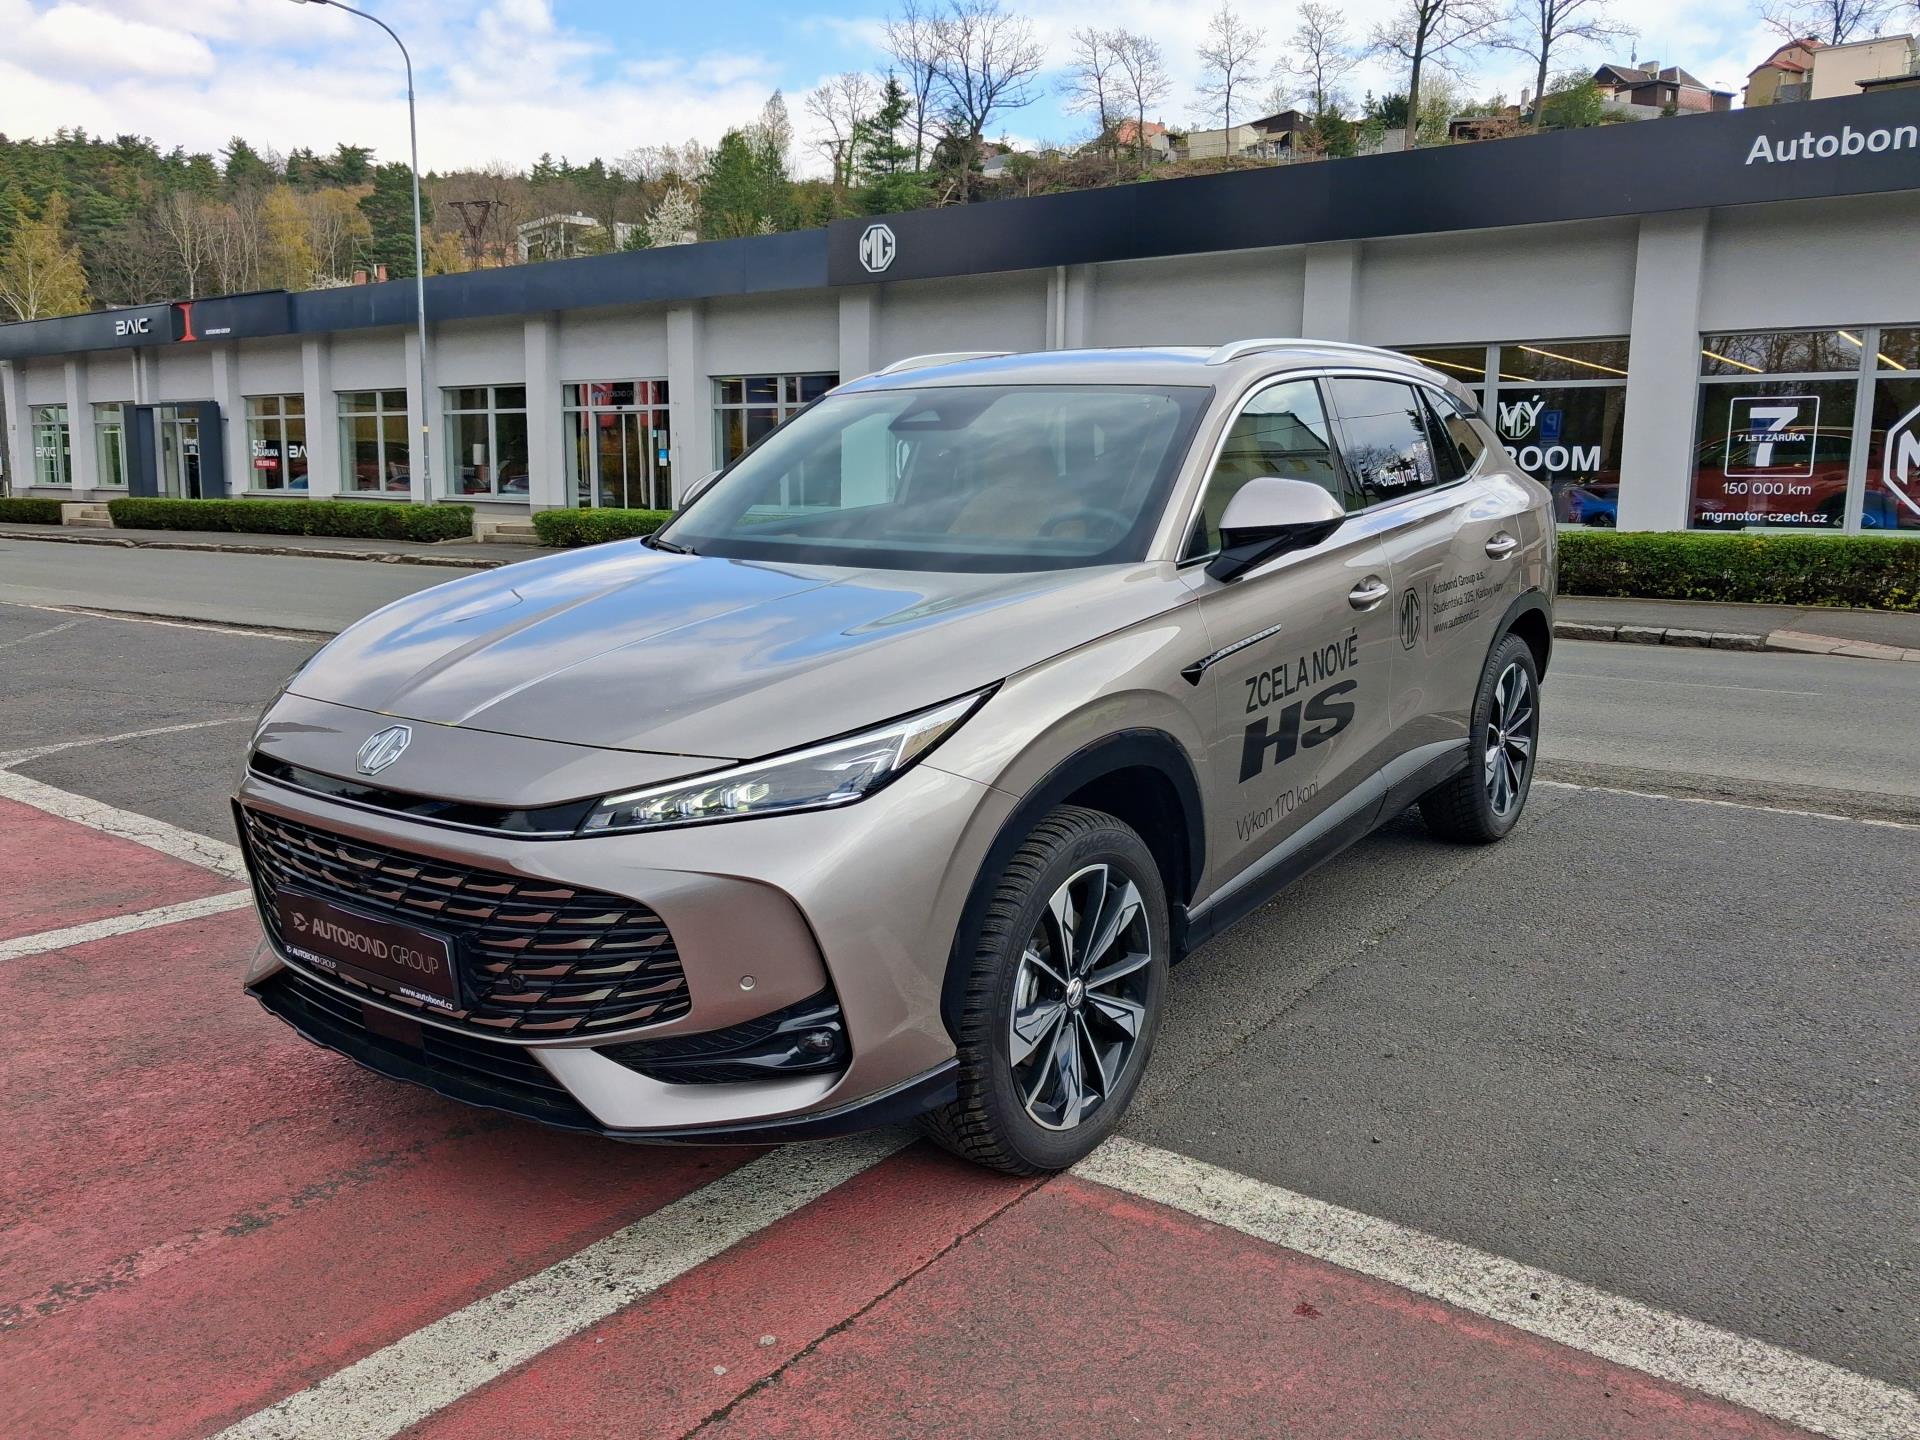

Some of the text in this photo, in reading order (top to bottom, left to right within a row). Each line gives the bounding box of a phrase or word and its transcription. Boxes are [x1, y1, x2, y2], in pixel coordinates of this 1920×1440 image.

[860, 223, 896, 273] MG
[115, 318, 149, 336] BAIC
[1737, 431, 1806, 442] 7 LET ZÁRUKA
[1722, 482, 1812, 495] 150 000 km
[1702, 510, 1828, 524] mgmotor-czech.cz
[1457, 573, 1476, 588] Group
[1400, 587, 1420, 651] MG
[1246, 627, 1357, 713] ZCELA NOVÉ
[356, 724, 412, 776] MG
[1238, 679, 1358, 785] HS
[1236, 806, 1273, 841] Výkon
[1274, 789, 1296, 818] 170
[312, 919, 438, 974] AUTOBOND GROUP
[400, 986, 453, 1010] www.autobond.cz
